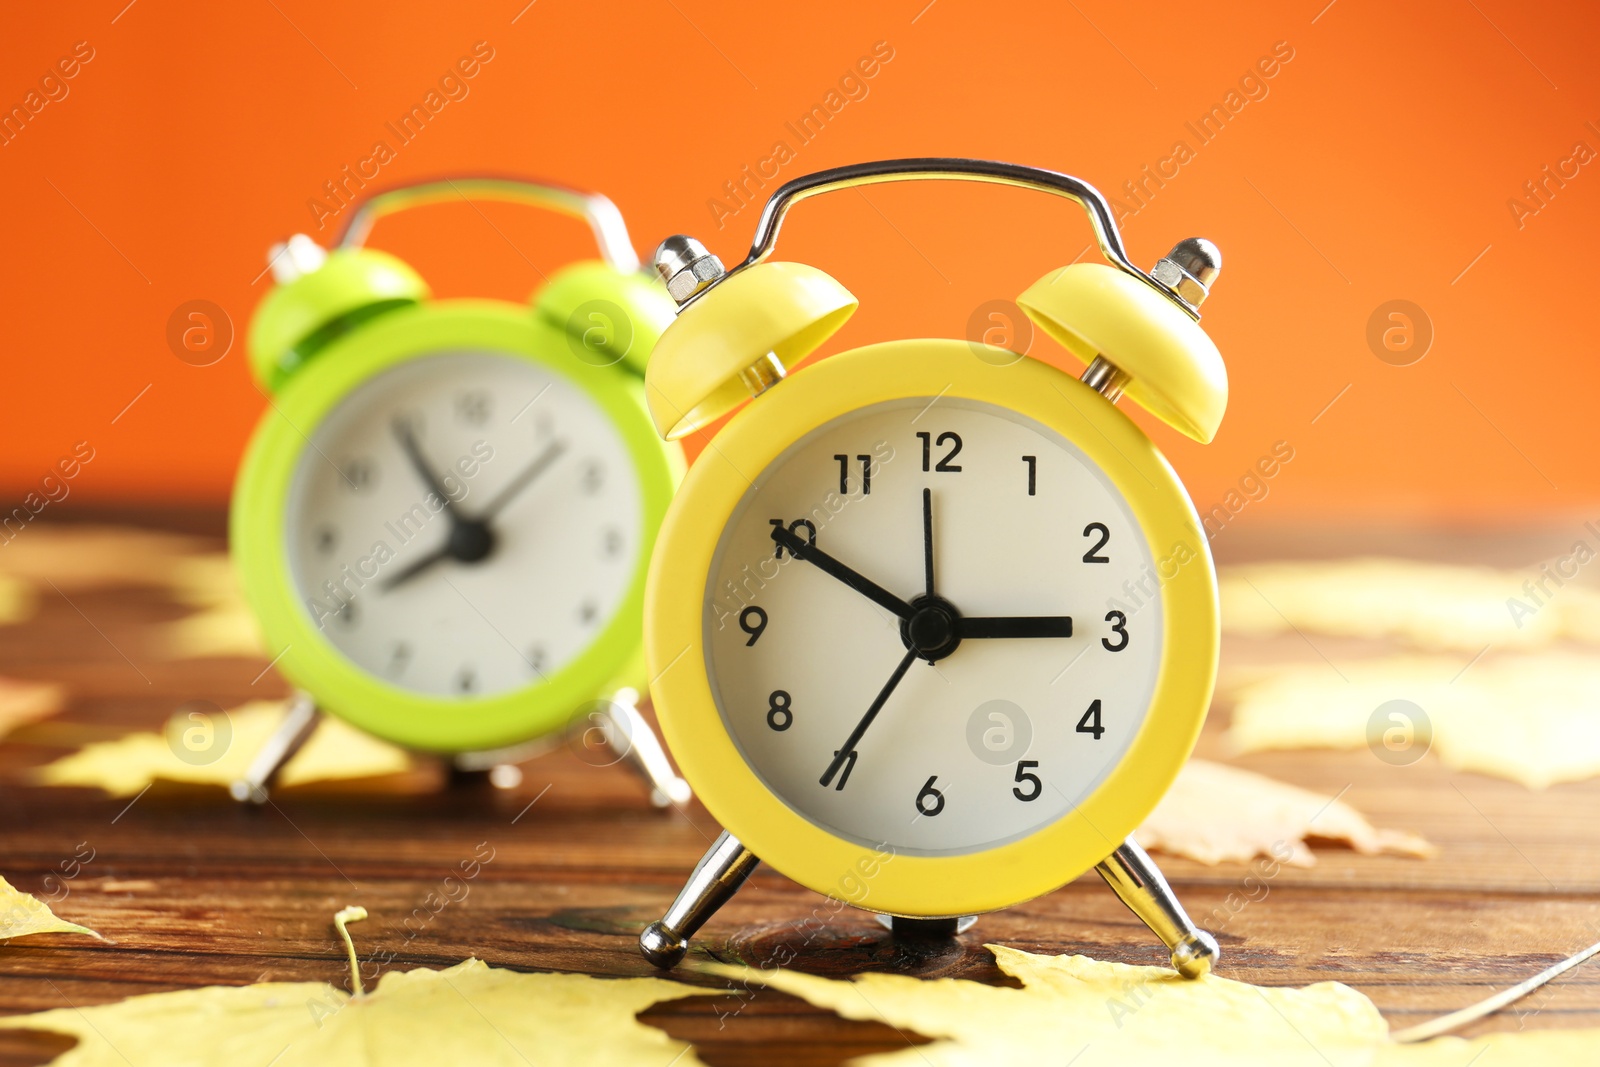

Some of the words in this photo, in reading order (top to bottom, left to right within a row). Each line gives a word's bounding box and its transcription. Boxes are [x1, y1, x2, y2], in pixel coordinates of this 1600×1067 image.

[916, 431, 963, 472] 12
[834, 454, 871, 495] 11
[1022, 455, 1036, 496] 1
[1082, 521, 1110, 563] 2
[739, 605, 768, 647] 9
[1101, 610, 1129, 652] 3
[766, 690, 793, 731] 8
[1076, 699, 1105, 740] 4
[915, 775, 945, 817] 6
[1012, 760, 1042, 802] 5
